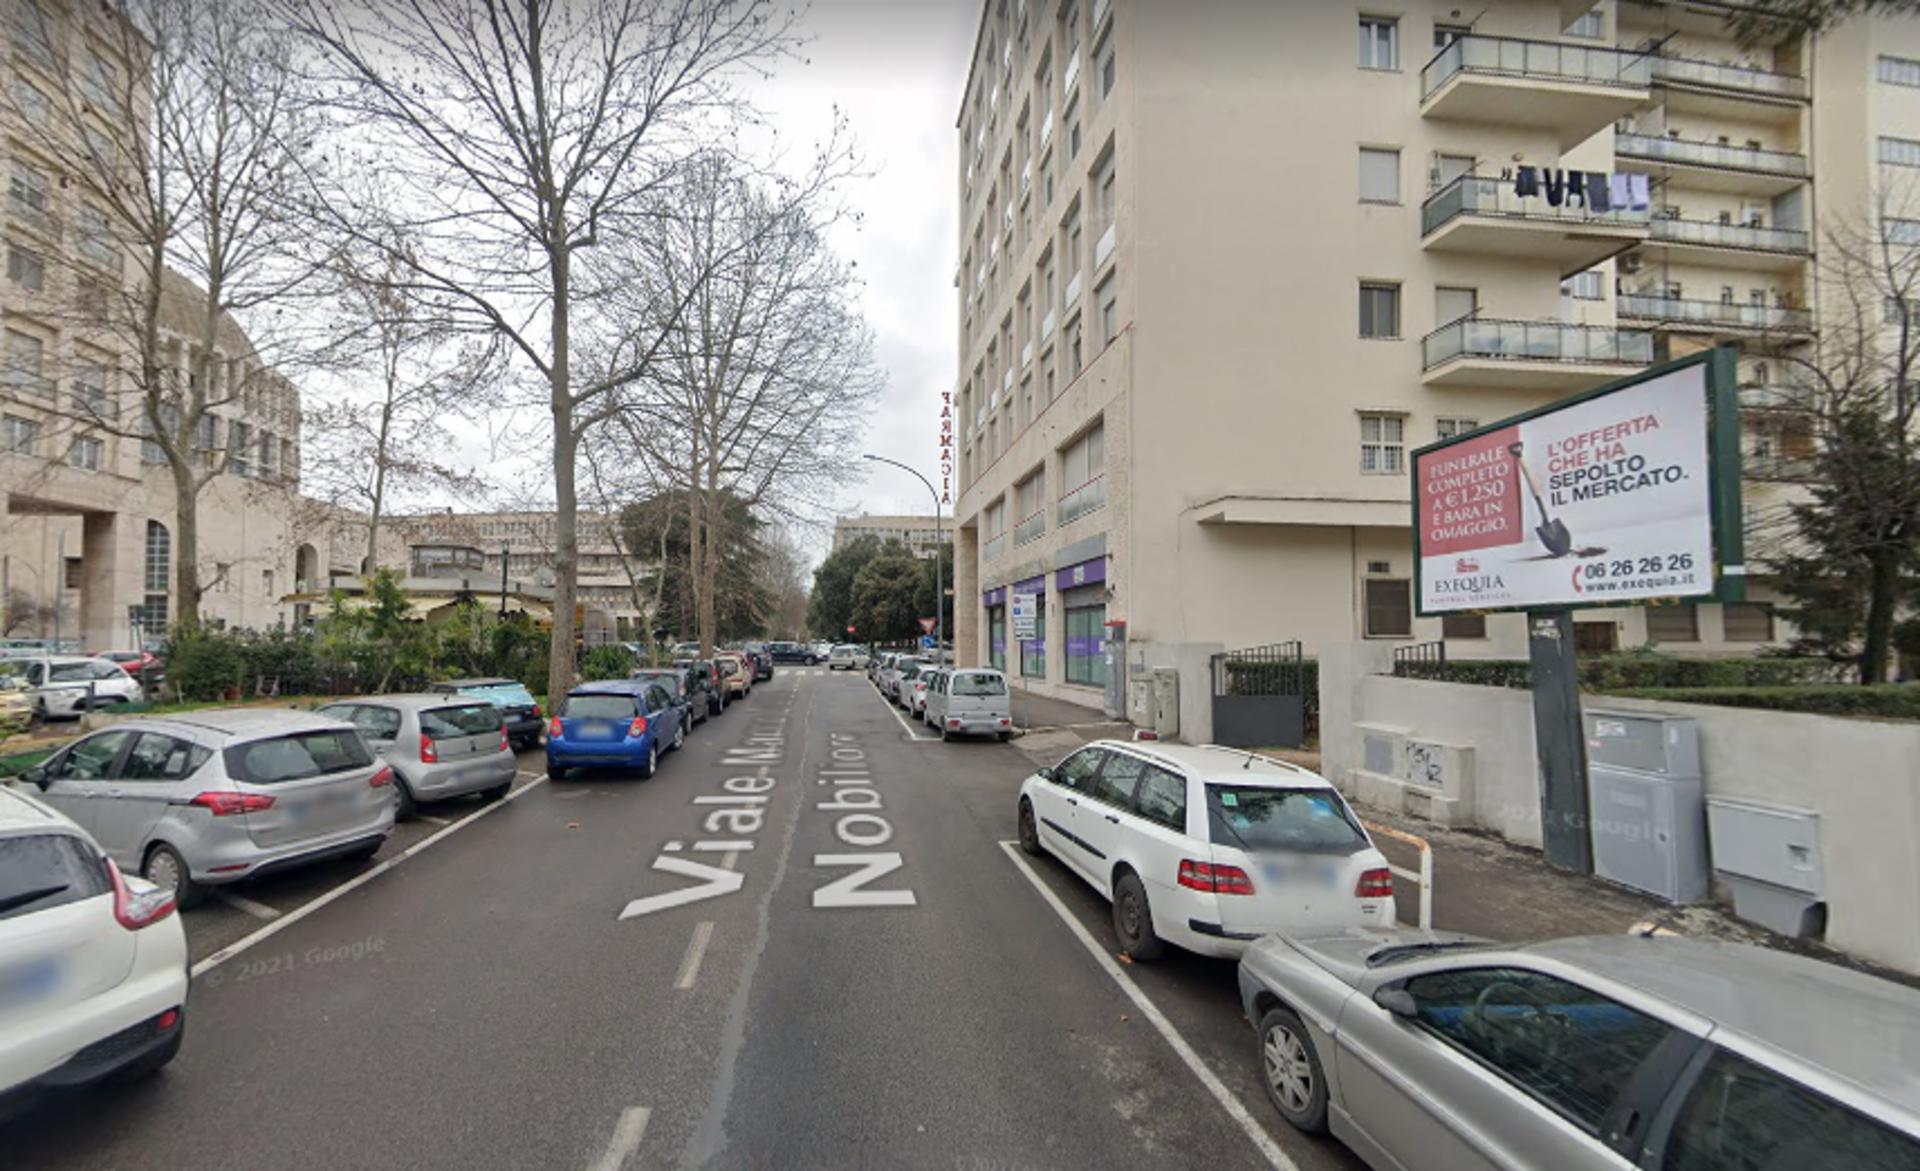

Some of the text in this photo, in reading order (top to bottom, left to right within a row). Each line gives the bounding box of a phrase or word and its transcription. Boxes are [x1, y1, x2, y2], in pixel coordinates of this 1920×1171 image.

[1547, 414, 1659, 458] L'OFFERTA
[1430, 446, 1504, 479] FUNERALE
[1548, 442, 1627, 474] CHE HA
[1549, 454, 1645, 490] SEPOLTO
[1427, 461, 1509, 494] COMPLETO
[1550, 465, 1690, 507] IL MERCATO.
[1432, 498, 1443, 511] A
[1432, 501, 1504, 526] E BARA IN
[1585, 553, 1693, 579] 06 26 26 26
[1434, 575, 1505, 593] EXEQUIA
[1585, 573, 1695, 592] www.exequia.it
